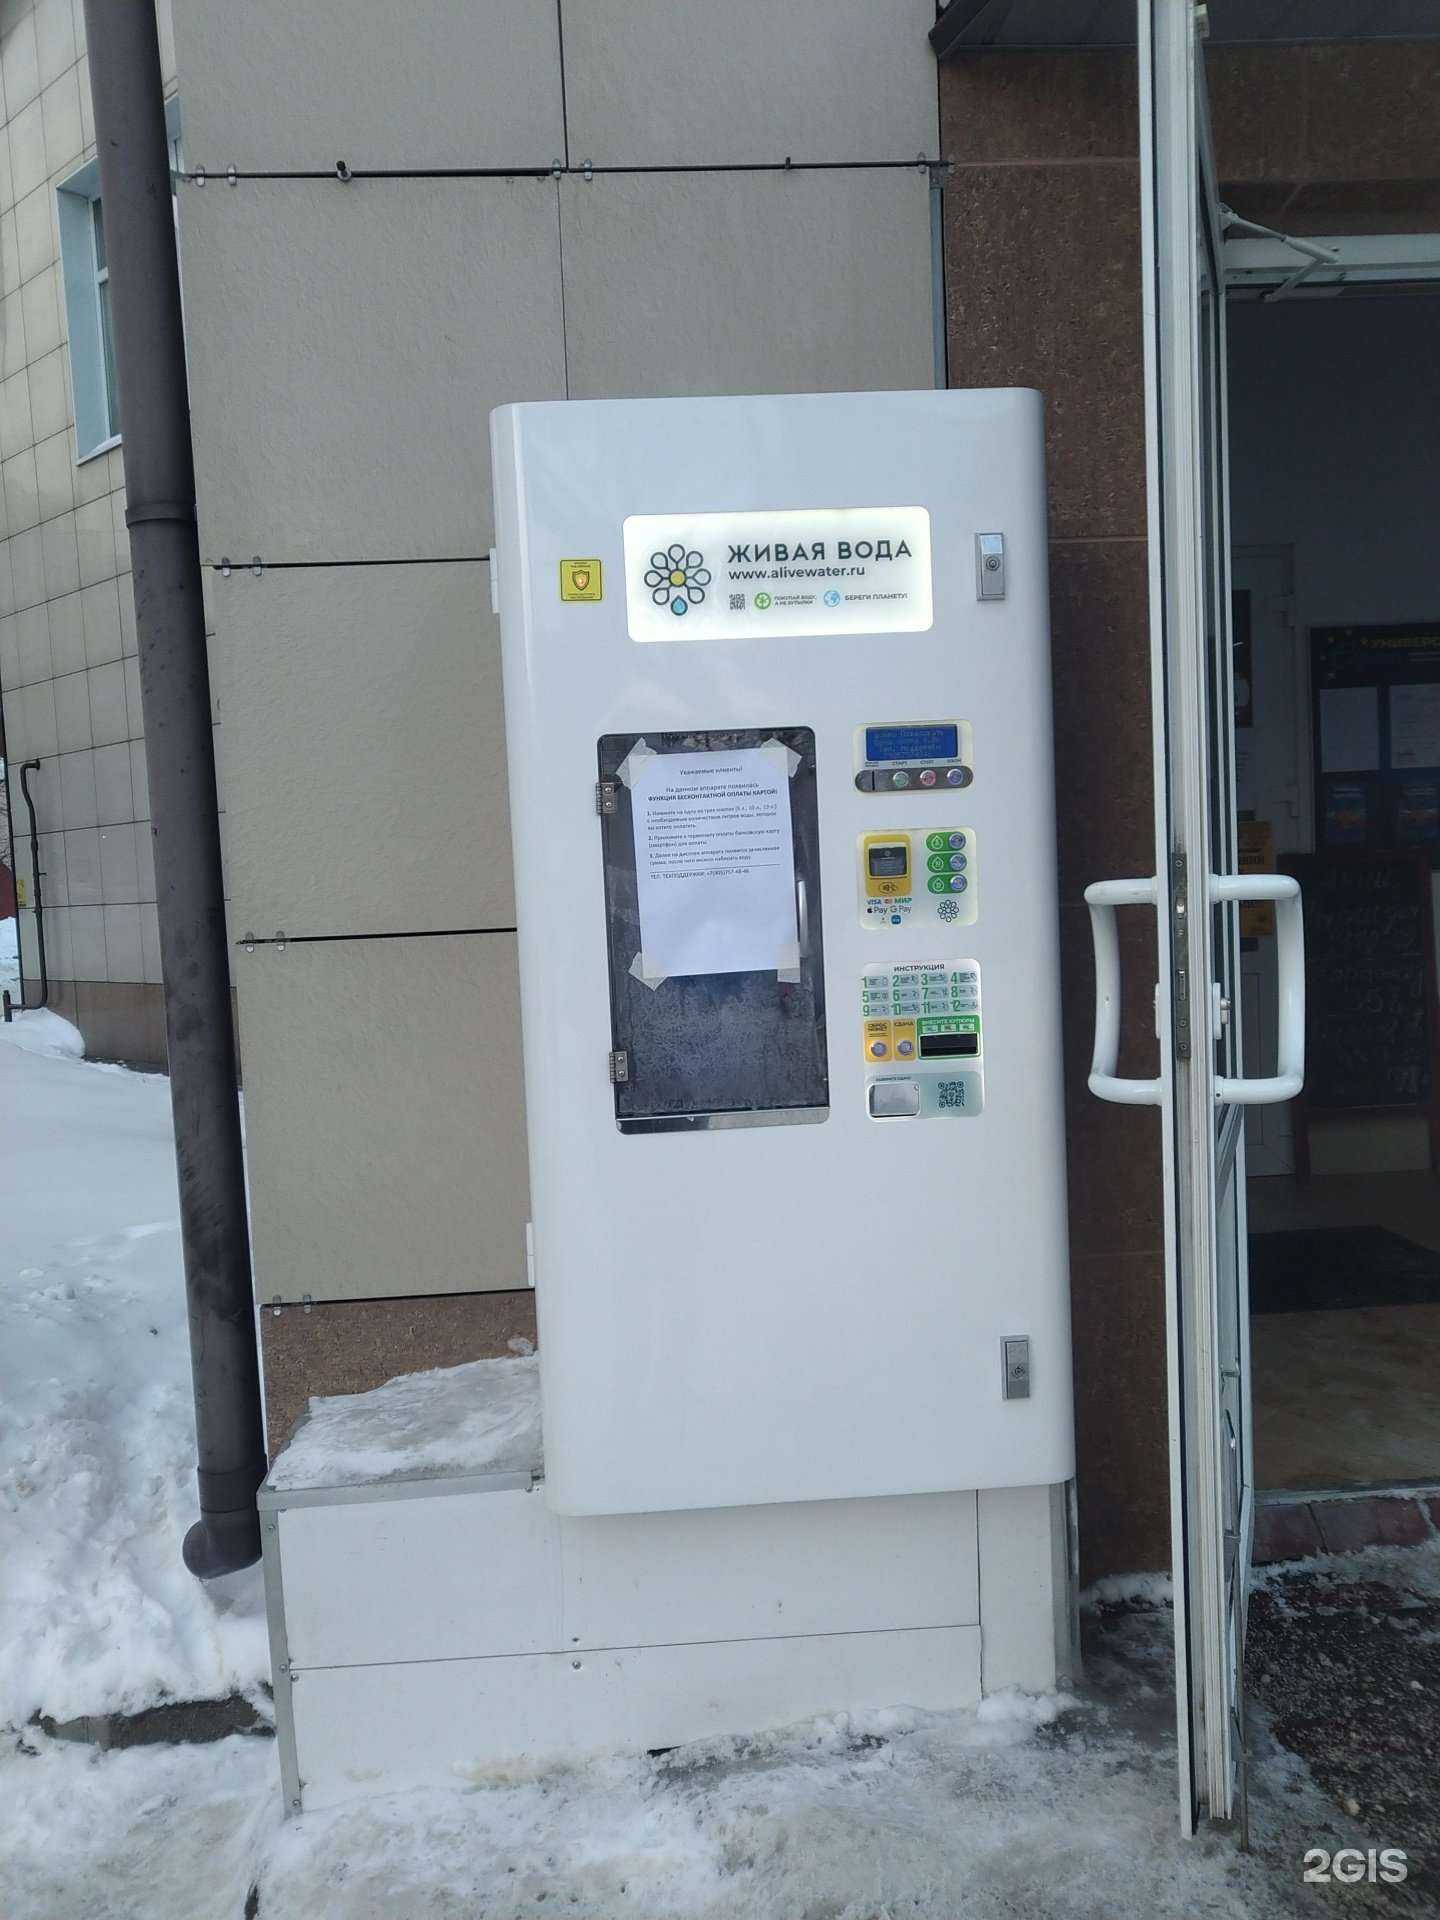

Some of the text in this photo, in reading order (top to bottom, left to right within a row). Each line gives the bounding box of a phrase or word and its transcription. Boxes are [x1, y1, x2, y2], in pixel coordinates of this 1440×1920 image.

[728, 540, 912, 563] ЖИВАЯ ВОДА
[728, 566, 865, 580] www.alivewater.ru
[874, 906, 888, 914] Pay
[894, 963, 945, 972] ИНСТРУКЦИЯ
[861, 976, 868, 989] 1
[892, 975, 900, 987] 2
[921, 973, 928, 986] 3
[950, 972, 958, 985] 4
[862, 990, 869, 1003] 5
[892, 989, 900, 1002] 6
[921, 987, 929, 1000] 7
[951, 985, 958, 998] 8
[862, 1004, 870, 1017] 9
